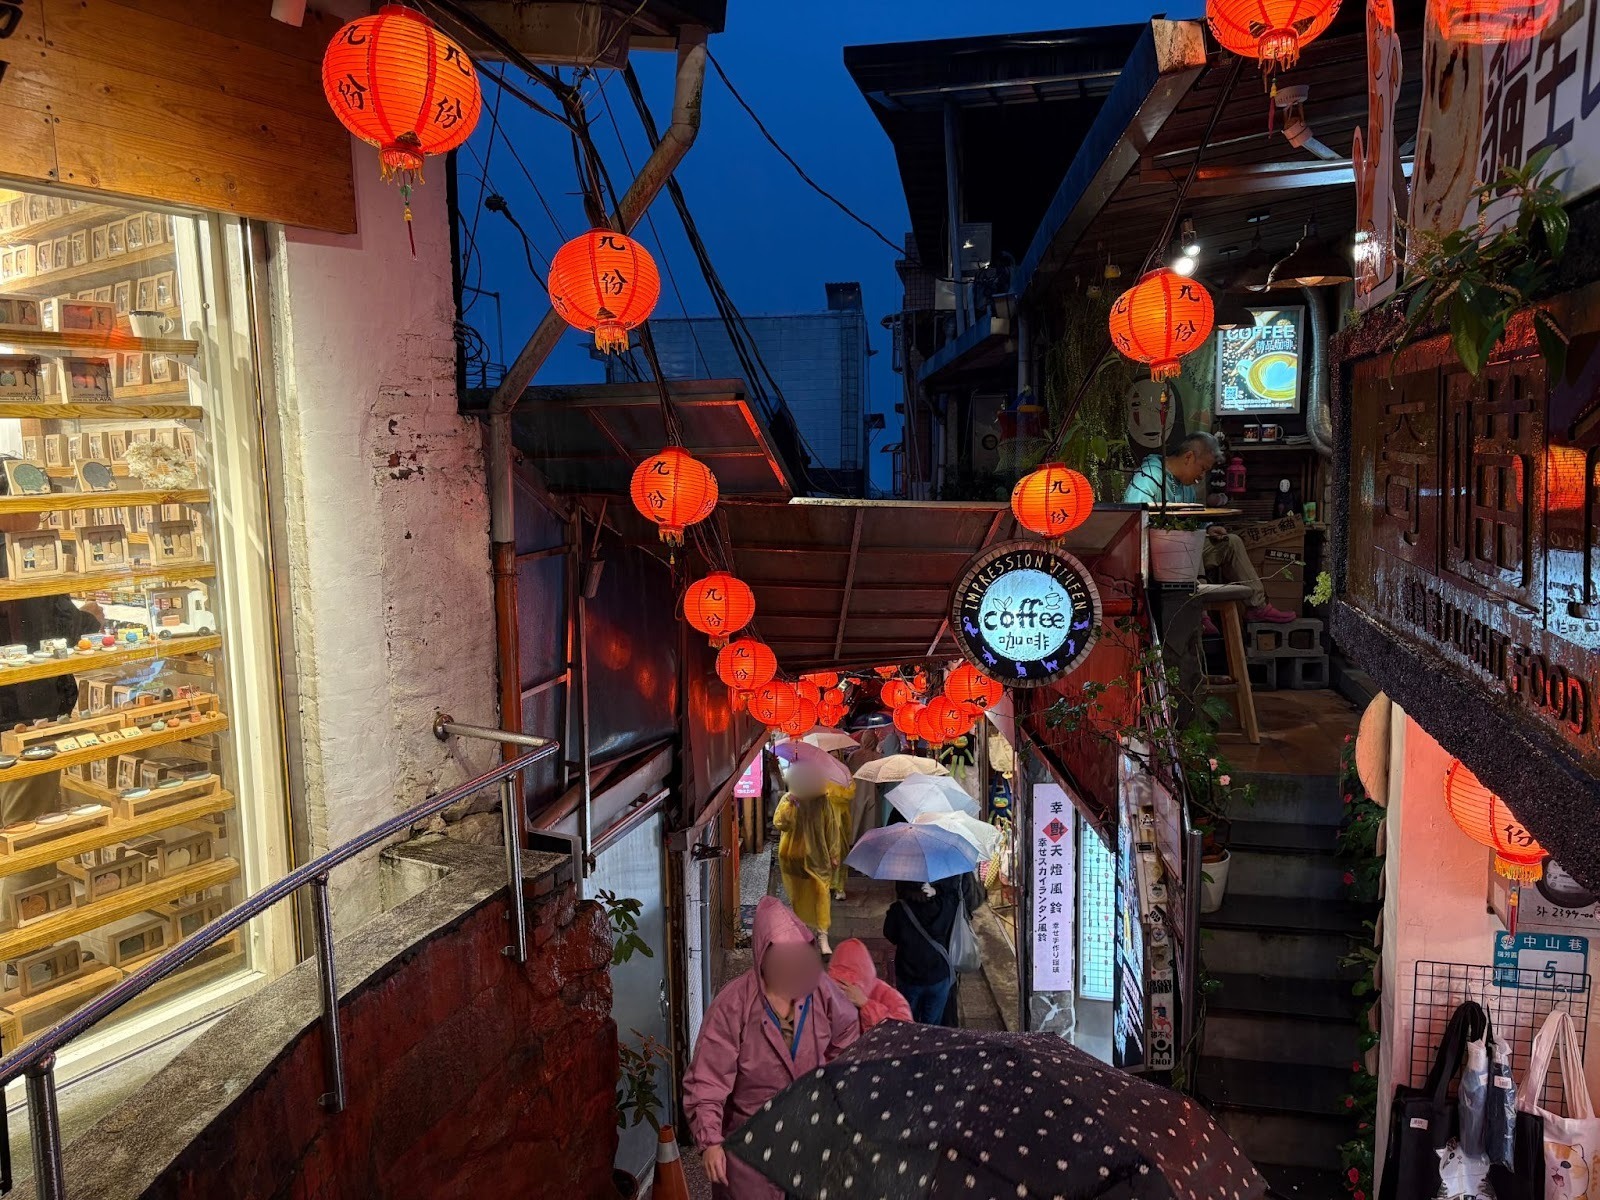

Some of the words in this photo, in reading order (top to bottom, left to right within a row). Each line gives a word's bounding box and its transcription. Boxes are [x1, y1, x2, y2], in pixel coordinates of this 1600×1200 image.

[337, 24, 369, 110] 九份
[434, 44, 474, 129] 九份
[598, 236, 628, 295] 九份
[1175, 284, 1200, 342] 九份
[1226, 325, 1295, 340] COFFEE
[647, 460, 670, 509] 九份
[1050, 480, 1071, 525] 九份
[965, 554, 1044, 610] IMPRESSION
[705, 588, 724, 628] 九份
[983, 597, 1065, 631] coffee
[999, 631, 1050, 651] 咖啡
[734, 647, 750, 681] 九份
[761, 689, 774, 719] 九份
[1497, 950, 1518, 960] 瑞芳區
[1523, 935, 1583, 951] 中山巷
[1543, 960, 1558, 979] 5
